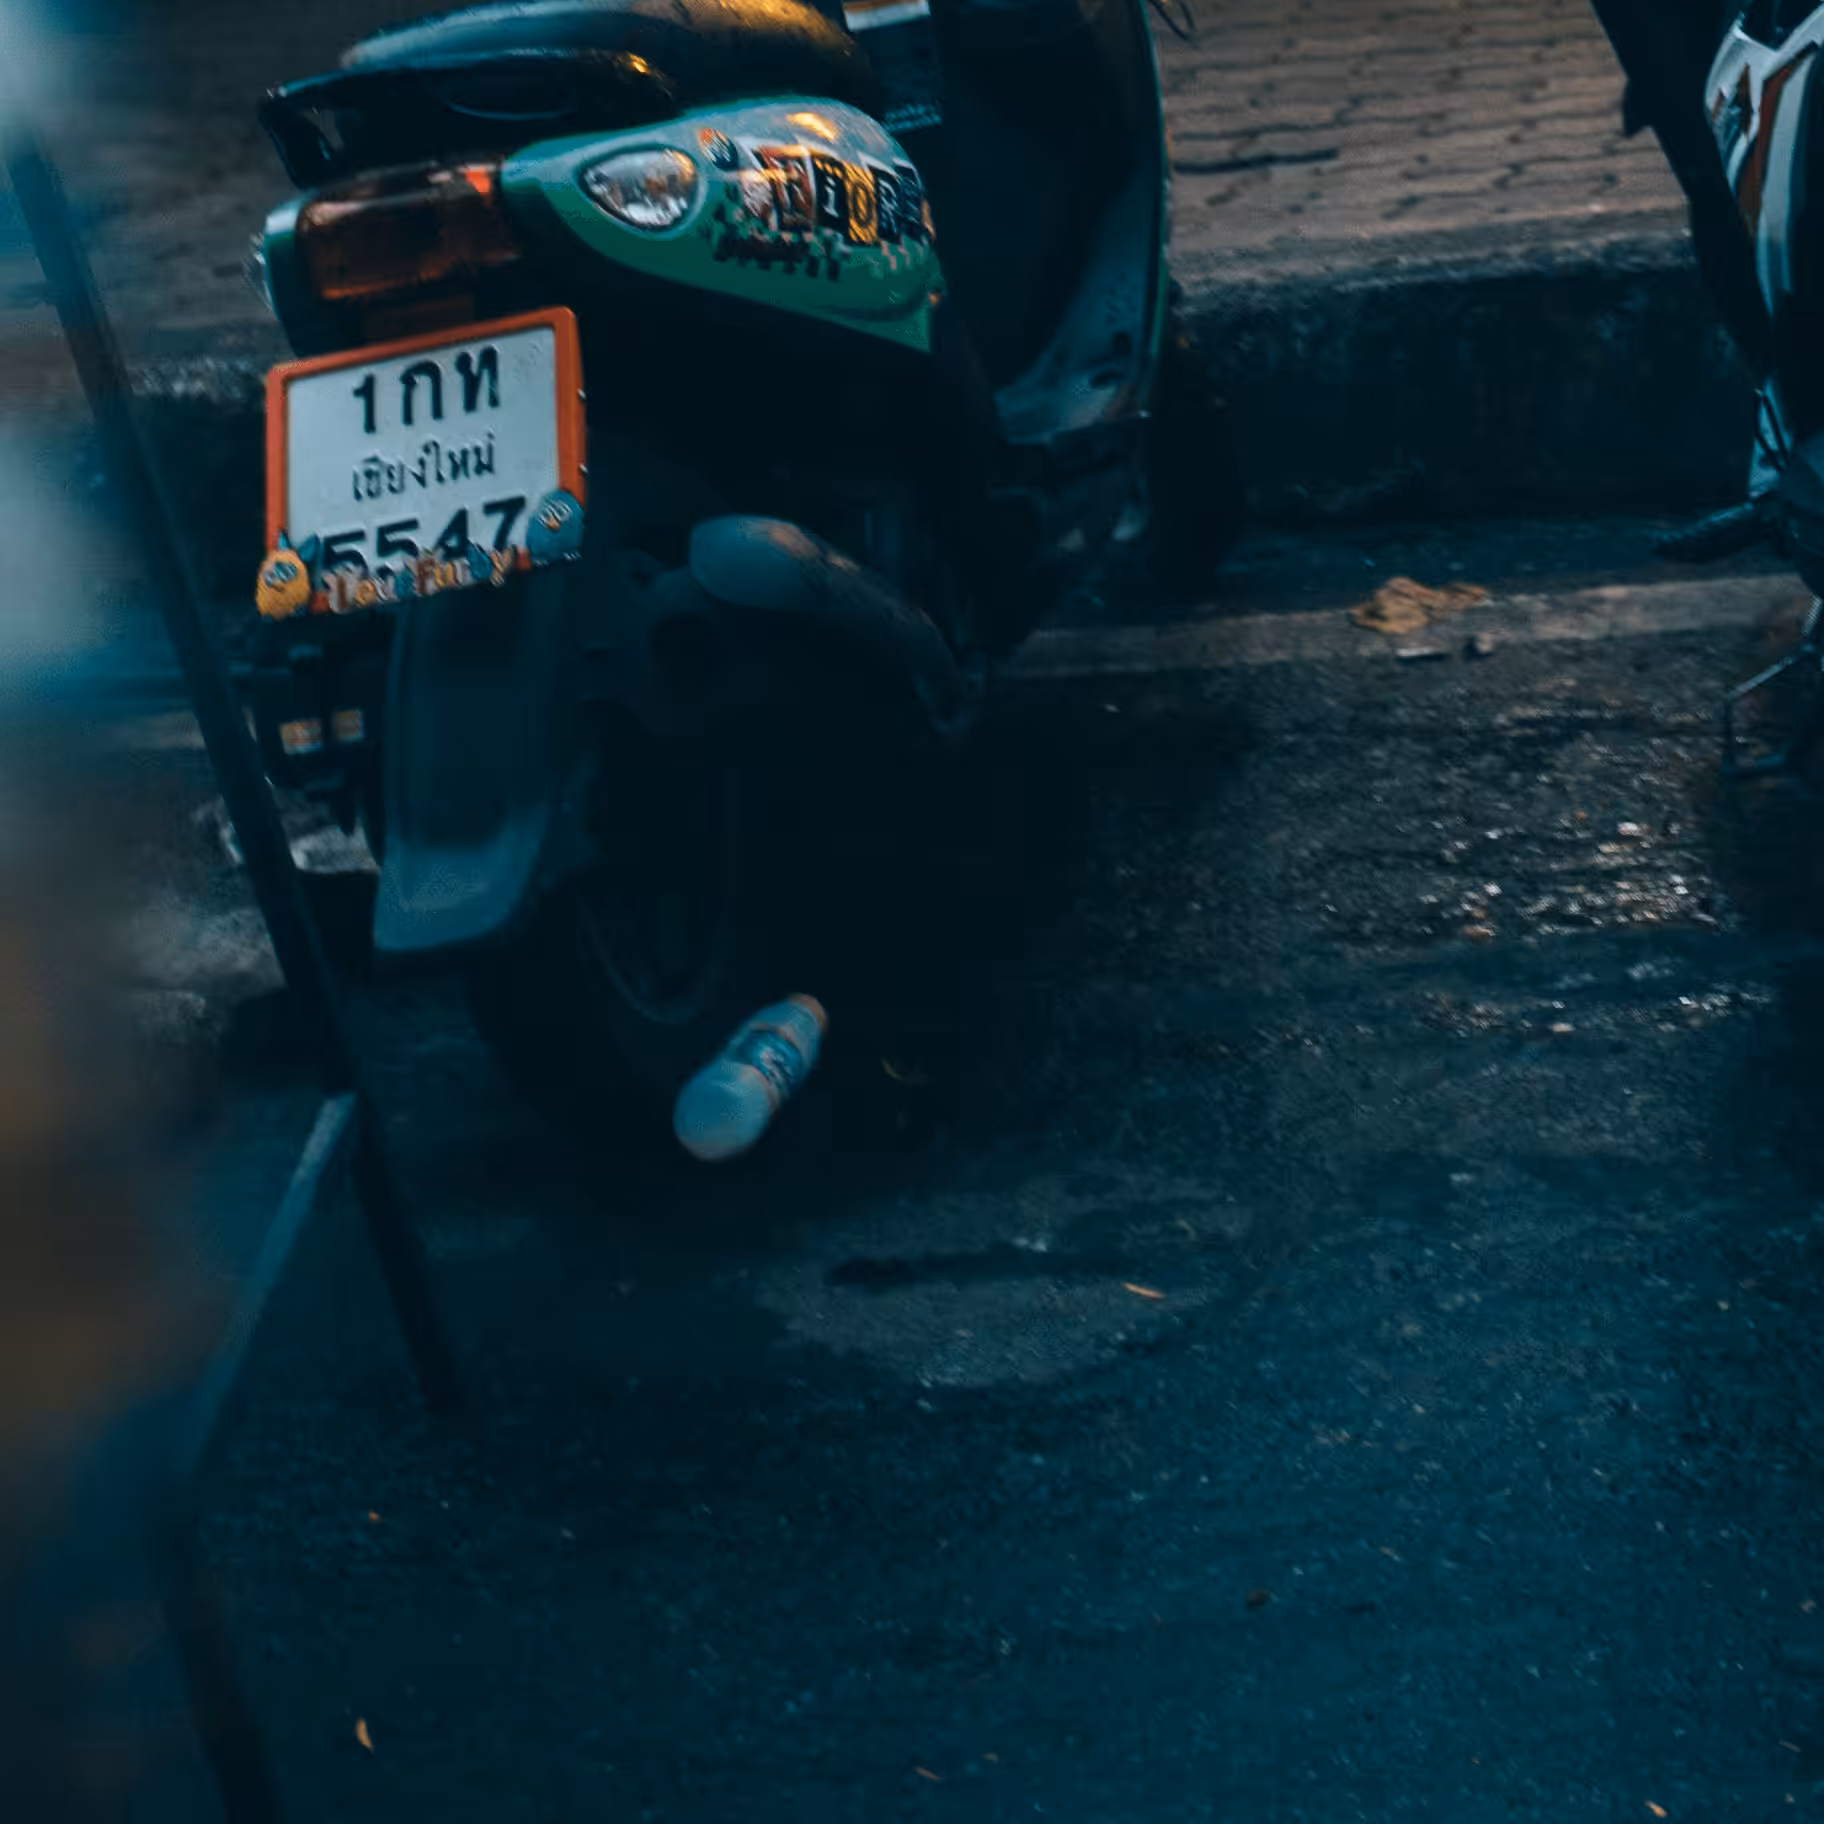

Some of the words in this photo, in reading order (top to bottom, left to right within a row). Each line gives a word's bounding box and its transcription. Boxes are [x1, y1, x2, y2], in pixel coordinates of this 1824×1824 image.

[353, 432, 496, 502] เชียงใหม่
[322, 495, 527, 580] 5547
